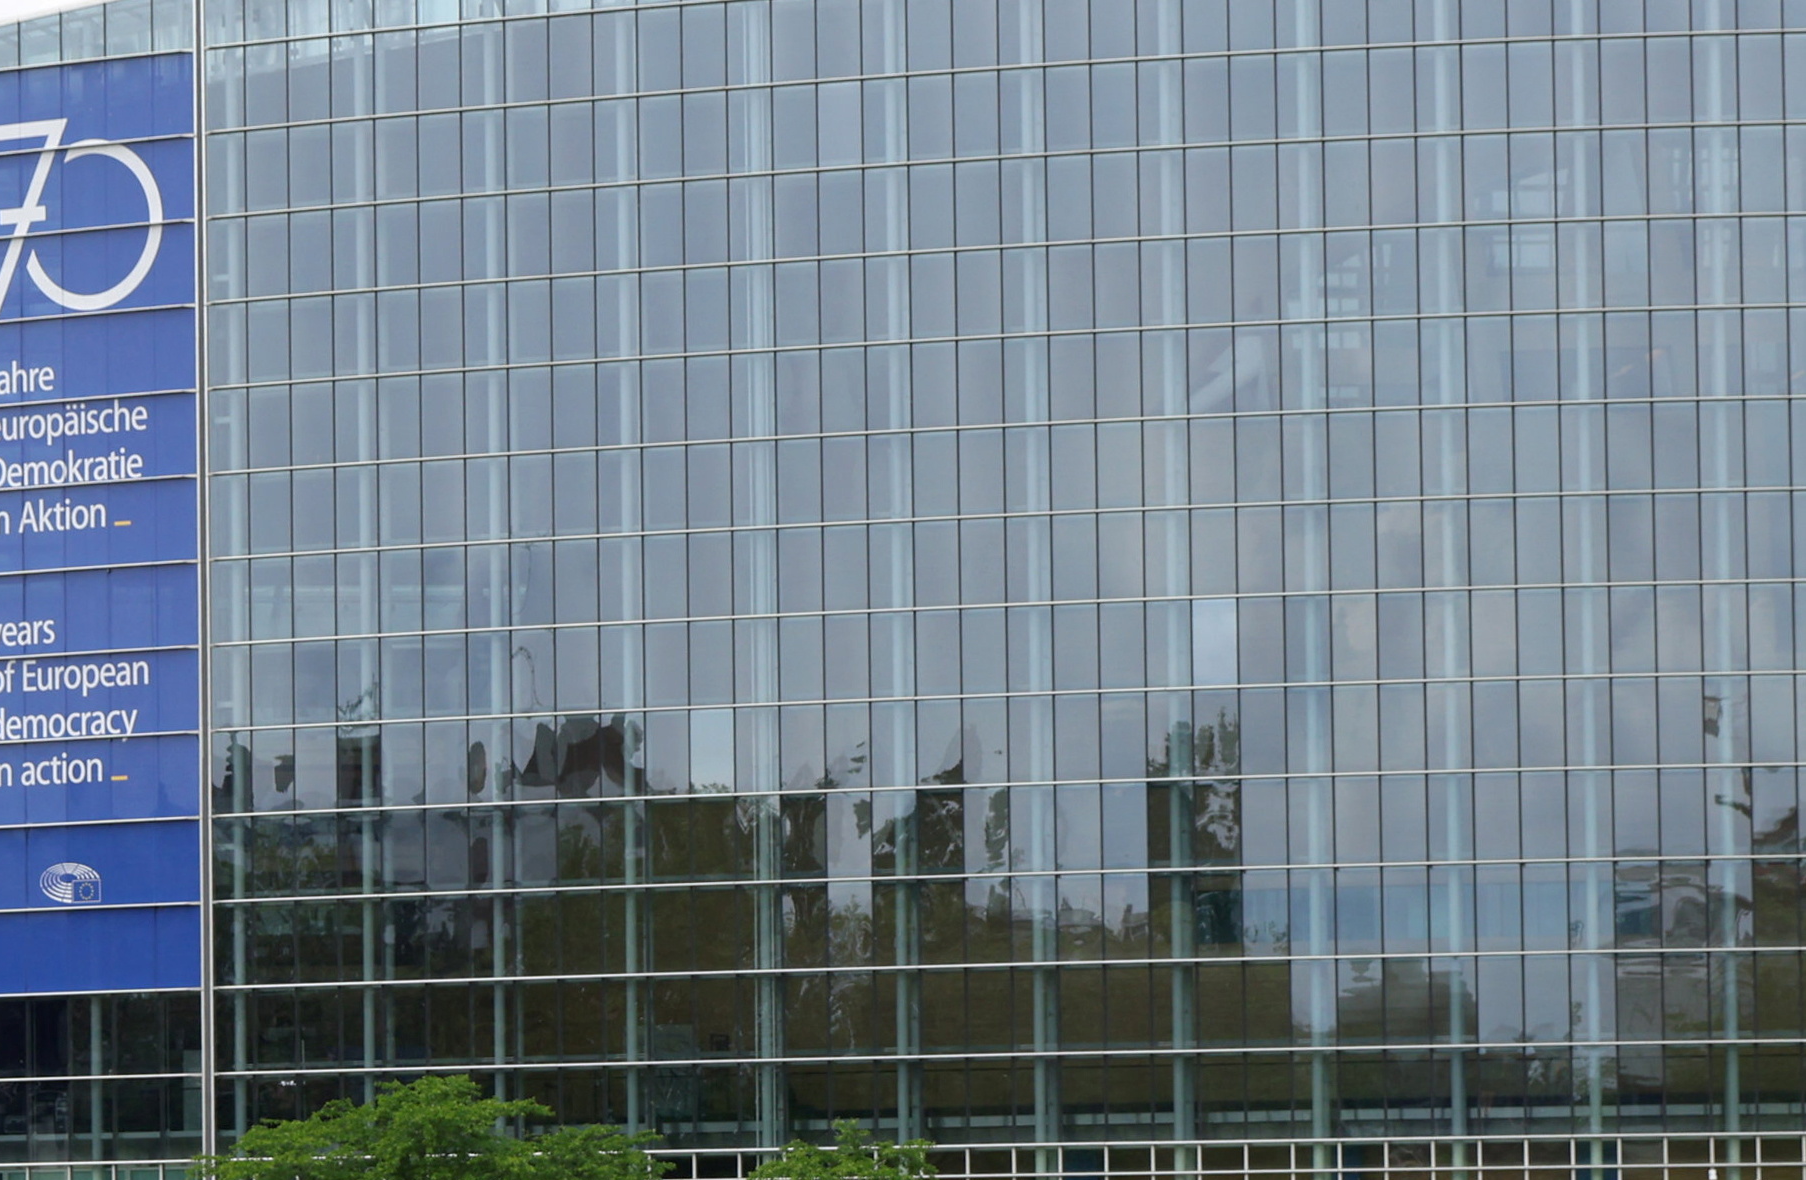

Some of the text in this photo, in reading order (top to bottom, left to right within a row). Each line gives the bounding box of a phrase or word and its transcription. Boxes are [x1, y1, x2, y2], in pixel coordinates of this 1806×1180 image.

[19, 499, 106, 534] Aktion
[22, 659, 149, 697] European
[21, 753, 103, 786] action
